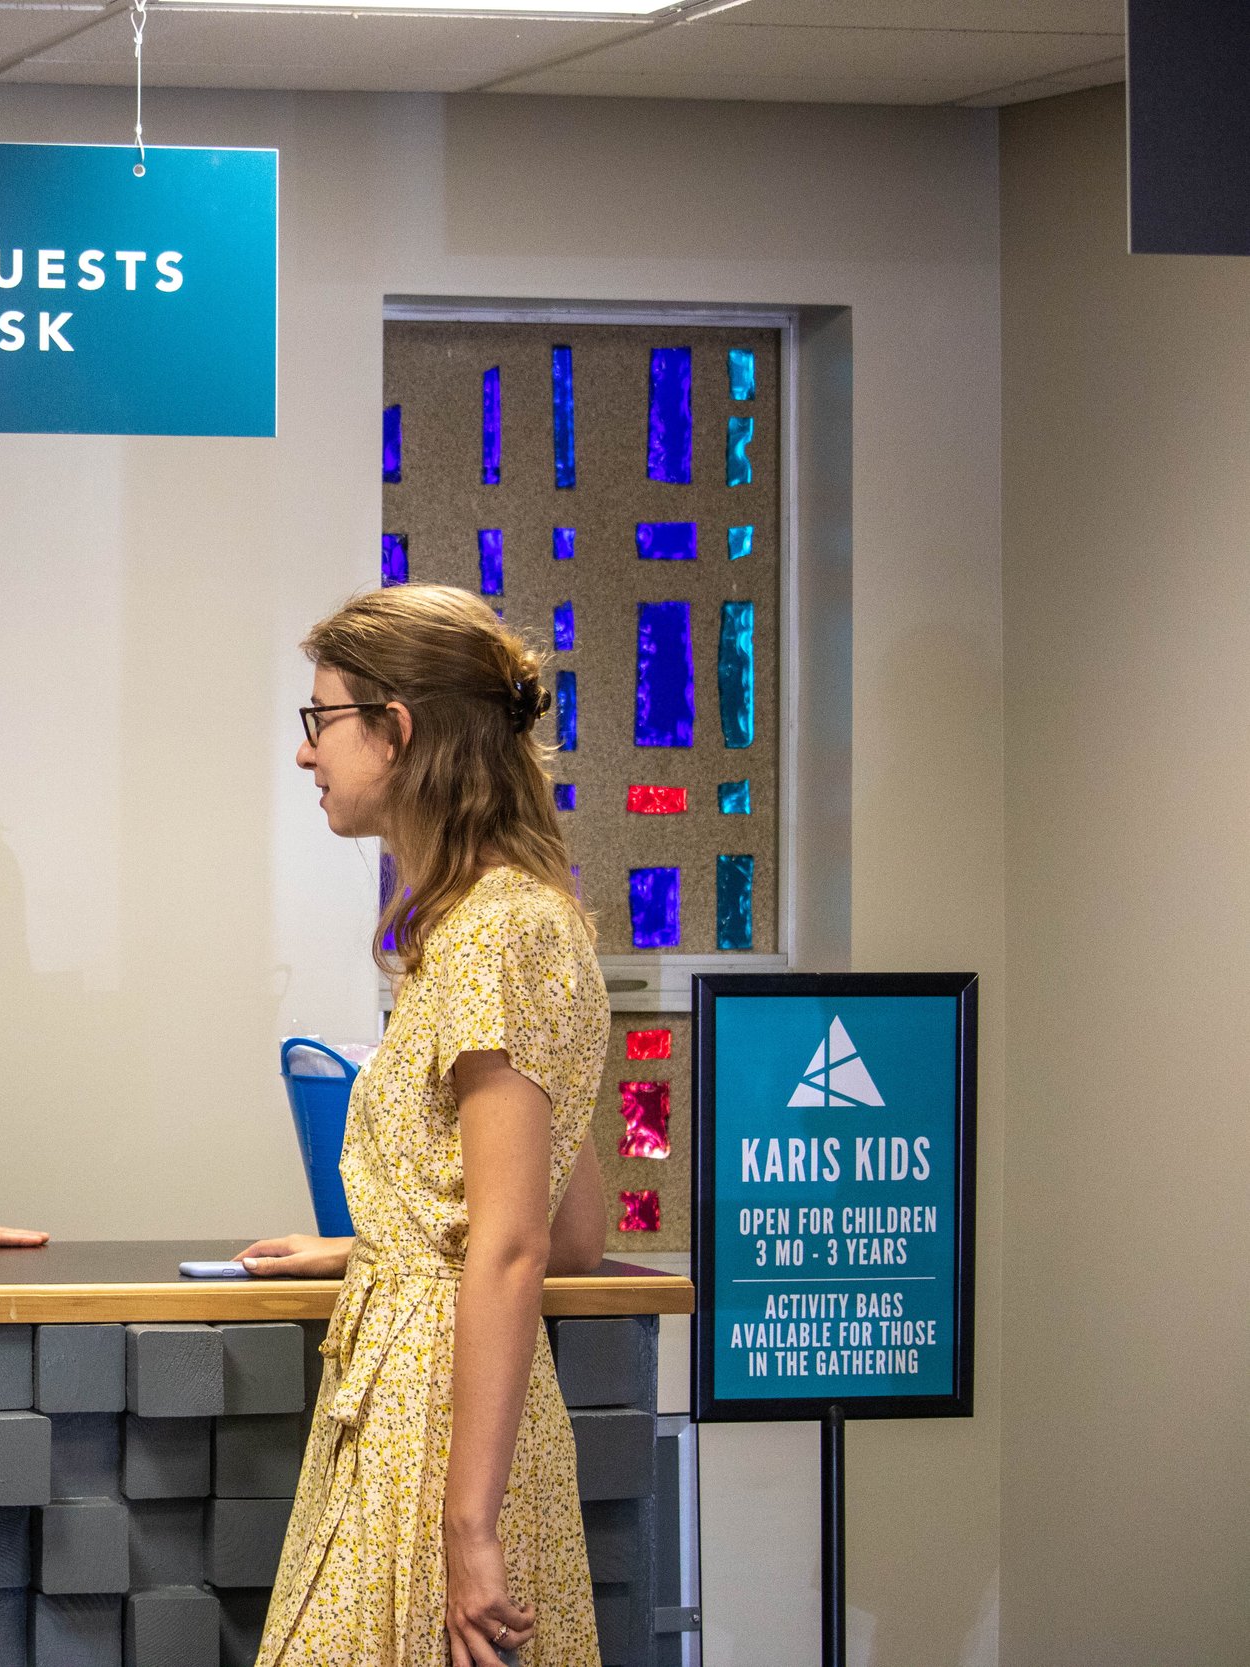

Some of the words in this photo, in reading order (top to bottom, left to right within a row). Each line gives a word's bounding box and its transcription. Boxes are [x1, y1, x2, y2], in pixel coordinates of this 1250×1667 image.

[741, 1137, 841, 1183] KARIS
[855, 1136, 930, 1182] KIDS
[739, 1208, 790, 1236] OPEN
[798, 1207, 834, 1235] FOR
[842, 1206, 937, 1234] CHILDREN
[756, 1239, 767, 1267] 3
[775, 1239, 804, 1266] MO
[827, 1238, 838, 1266] 3
[846, 1237, 907, 1265] YEARS
[765, 1294, 849, 1320] ACTIVITY
[856, 1292, 903, 1318] BAGS
[730, 1322, 832, 1348] AVAILABLE
[839, 1321, 872, 1347] FOR
[879, 1320, 936, 1346] THOSE
[749, 1351, 767, 1377] IN
[774, 1351, 809, 1376] THE
[816, 1349, 918, 1376] GATHERING
